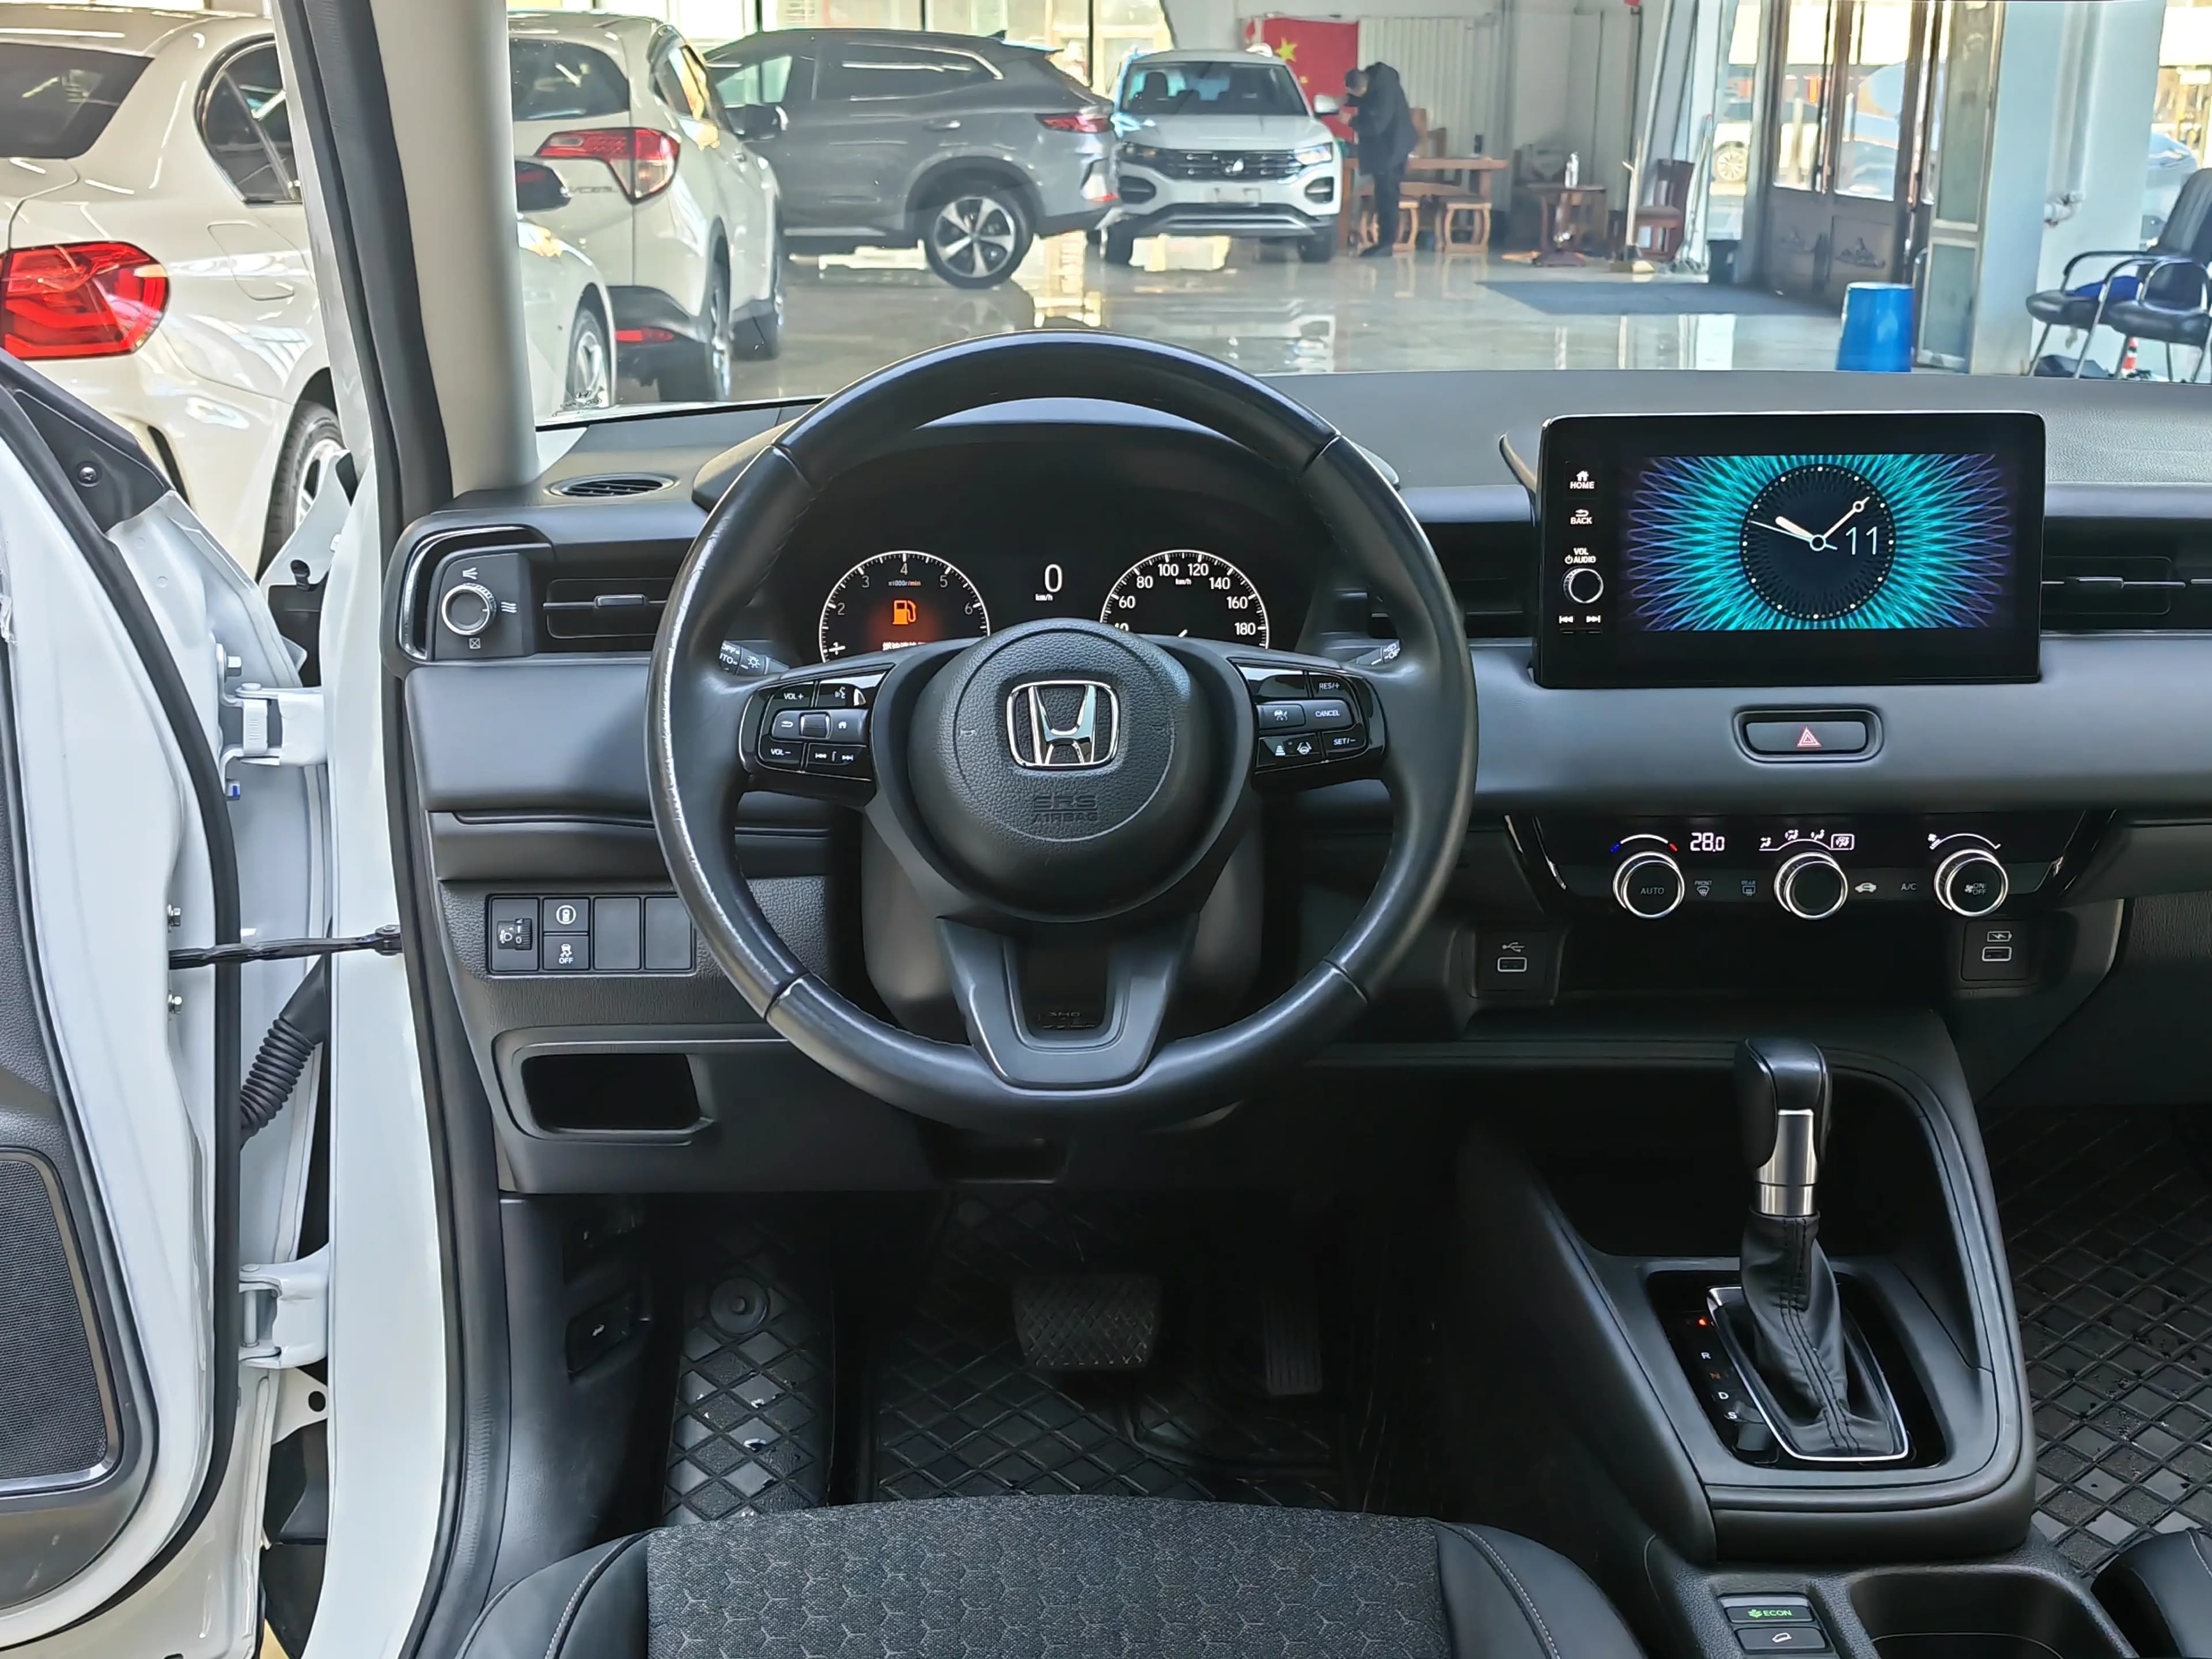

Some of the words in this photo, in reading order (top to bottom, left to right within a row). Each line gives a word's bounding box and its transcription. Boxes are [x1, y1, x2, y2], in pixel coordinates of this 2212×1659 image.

[1845, 526, 1877, 555] 11
[900, 563, 908, 575] 4
[1158, 563, 1179, 576] 100
[1188, 563, 1209, 576] 120
[862, 576, 870, 588] 3
[940, 575, 948, 588] 5
[1044, 564, 1063, 592] 0
[1137, 576, 1153, 589] 80
[1209, 577, 1230, 590] 140
[837, 603, 845, 615] 2
[964, 603, 973, 615] 6
[1119, 596, 1135, 609] 60
[1226, 596, 1248, 609] 160
[1234, 622, 1255, 635] 180
[1690, 832, 1725, 852] 28.0
[1718, 1392, 1729, 1400] D
[1728, 1411, 1737, 1419] S
